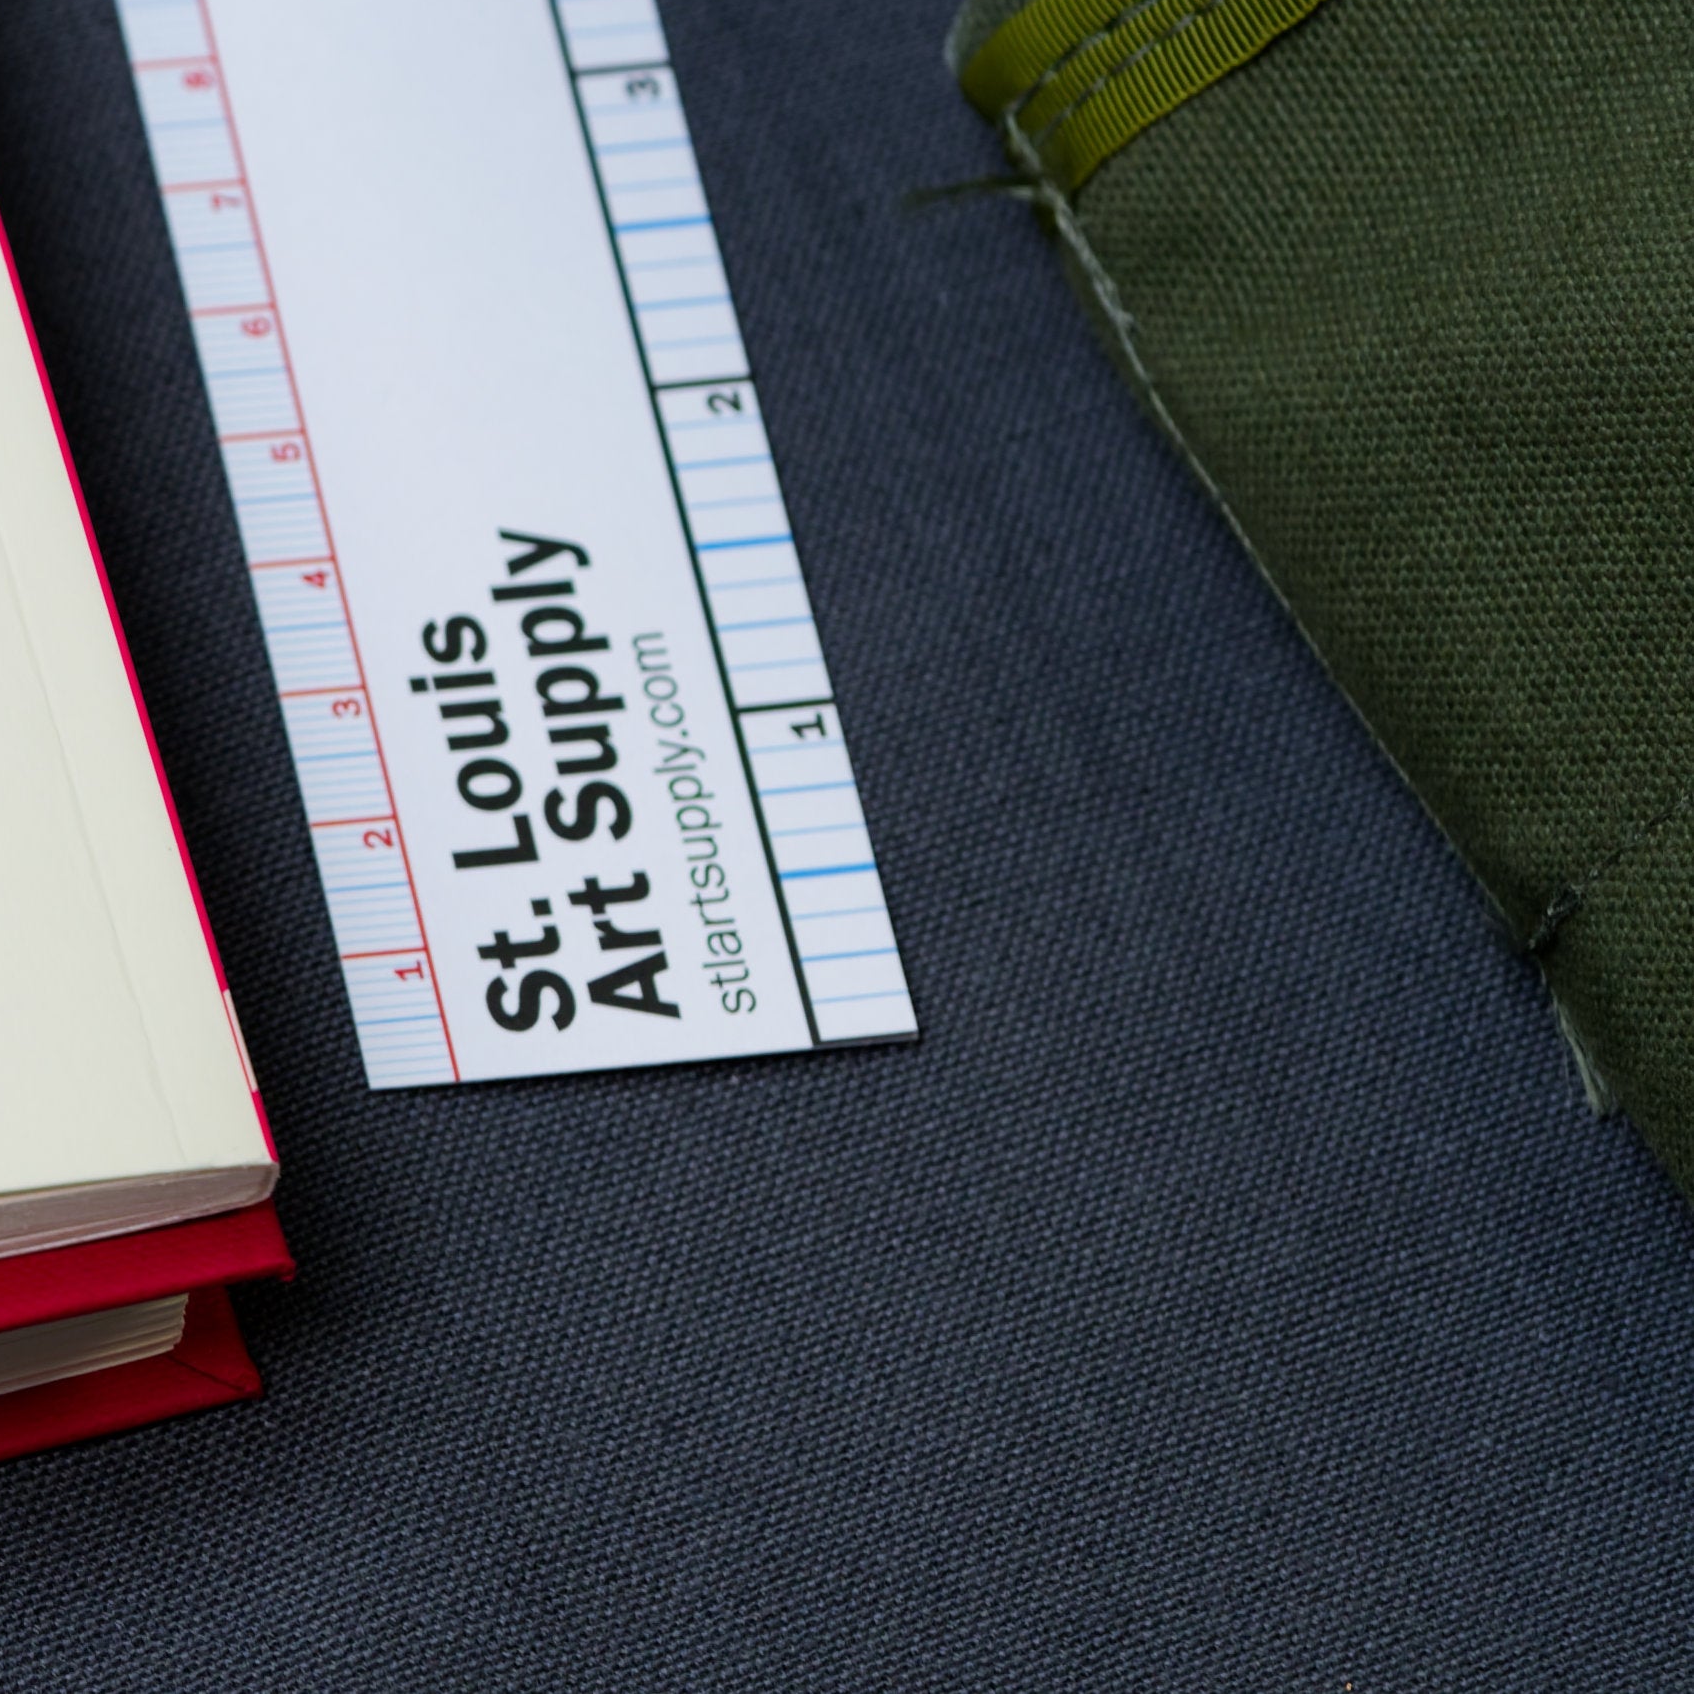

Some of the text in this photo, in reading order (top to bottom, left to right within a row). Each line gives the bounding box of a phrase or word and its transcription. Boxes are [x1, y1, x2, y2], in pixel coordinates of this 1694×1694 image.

[183, 69, 213, 91] 8
[626, 74, 660, 101] 3
[211, 190, 243, 213] 7
[241, 316, 273, 338] 6
[707, 391, 743, 417] 2
[269, 442, 301, 464] 5
[301, 570, 330, 590] 4
[333, 695, 363, 719] 3
[791, 711, 829, 740] 1
[490, 528, 683, 1020] Art Supply
[408, 613, 579, 1033] St. Louis
[632, 631, 757, 1015] stlartsupply.com
[362, 825, 395, 851] 2
[395, 960, 425, 983] 1
